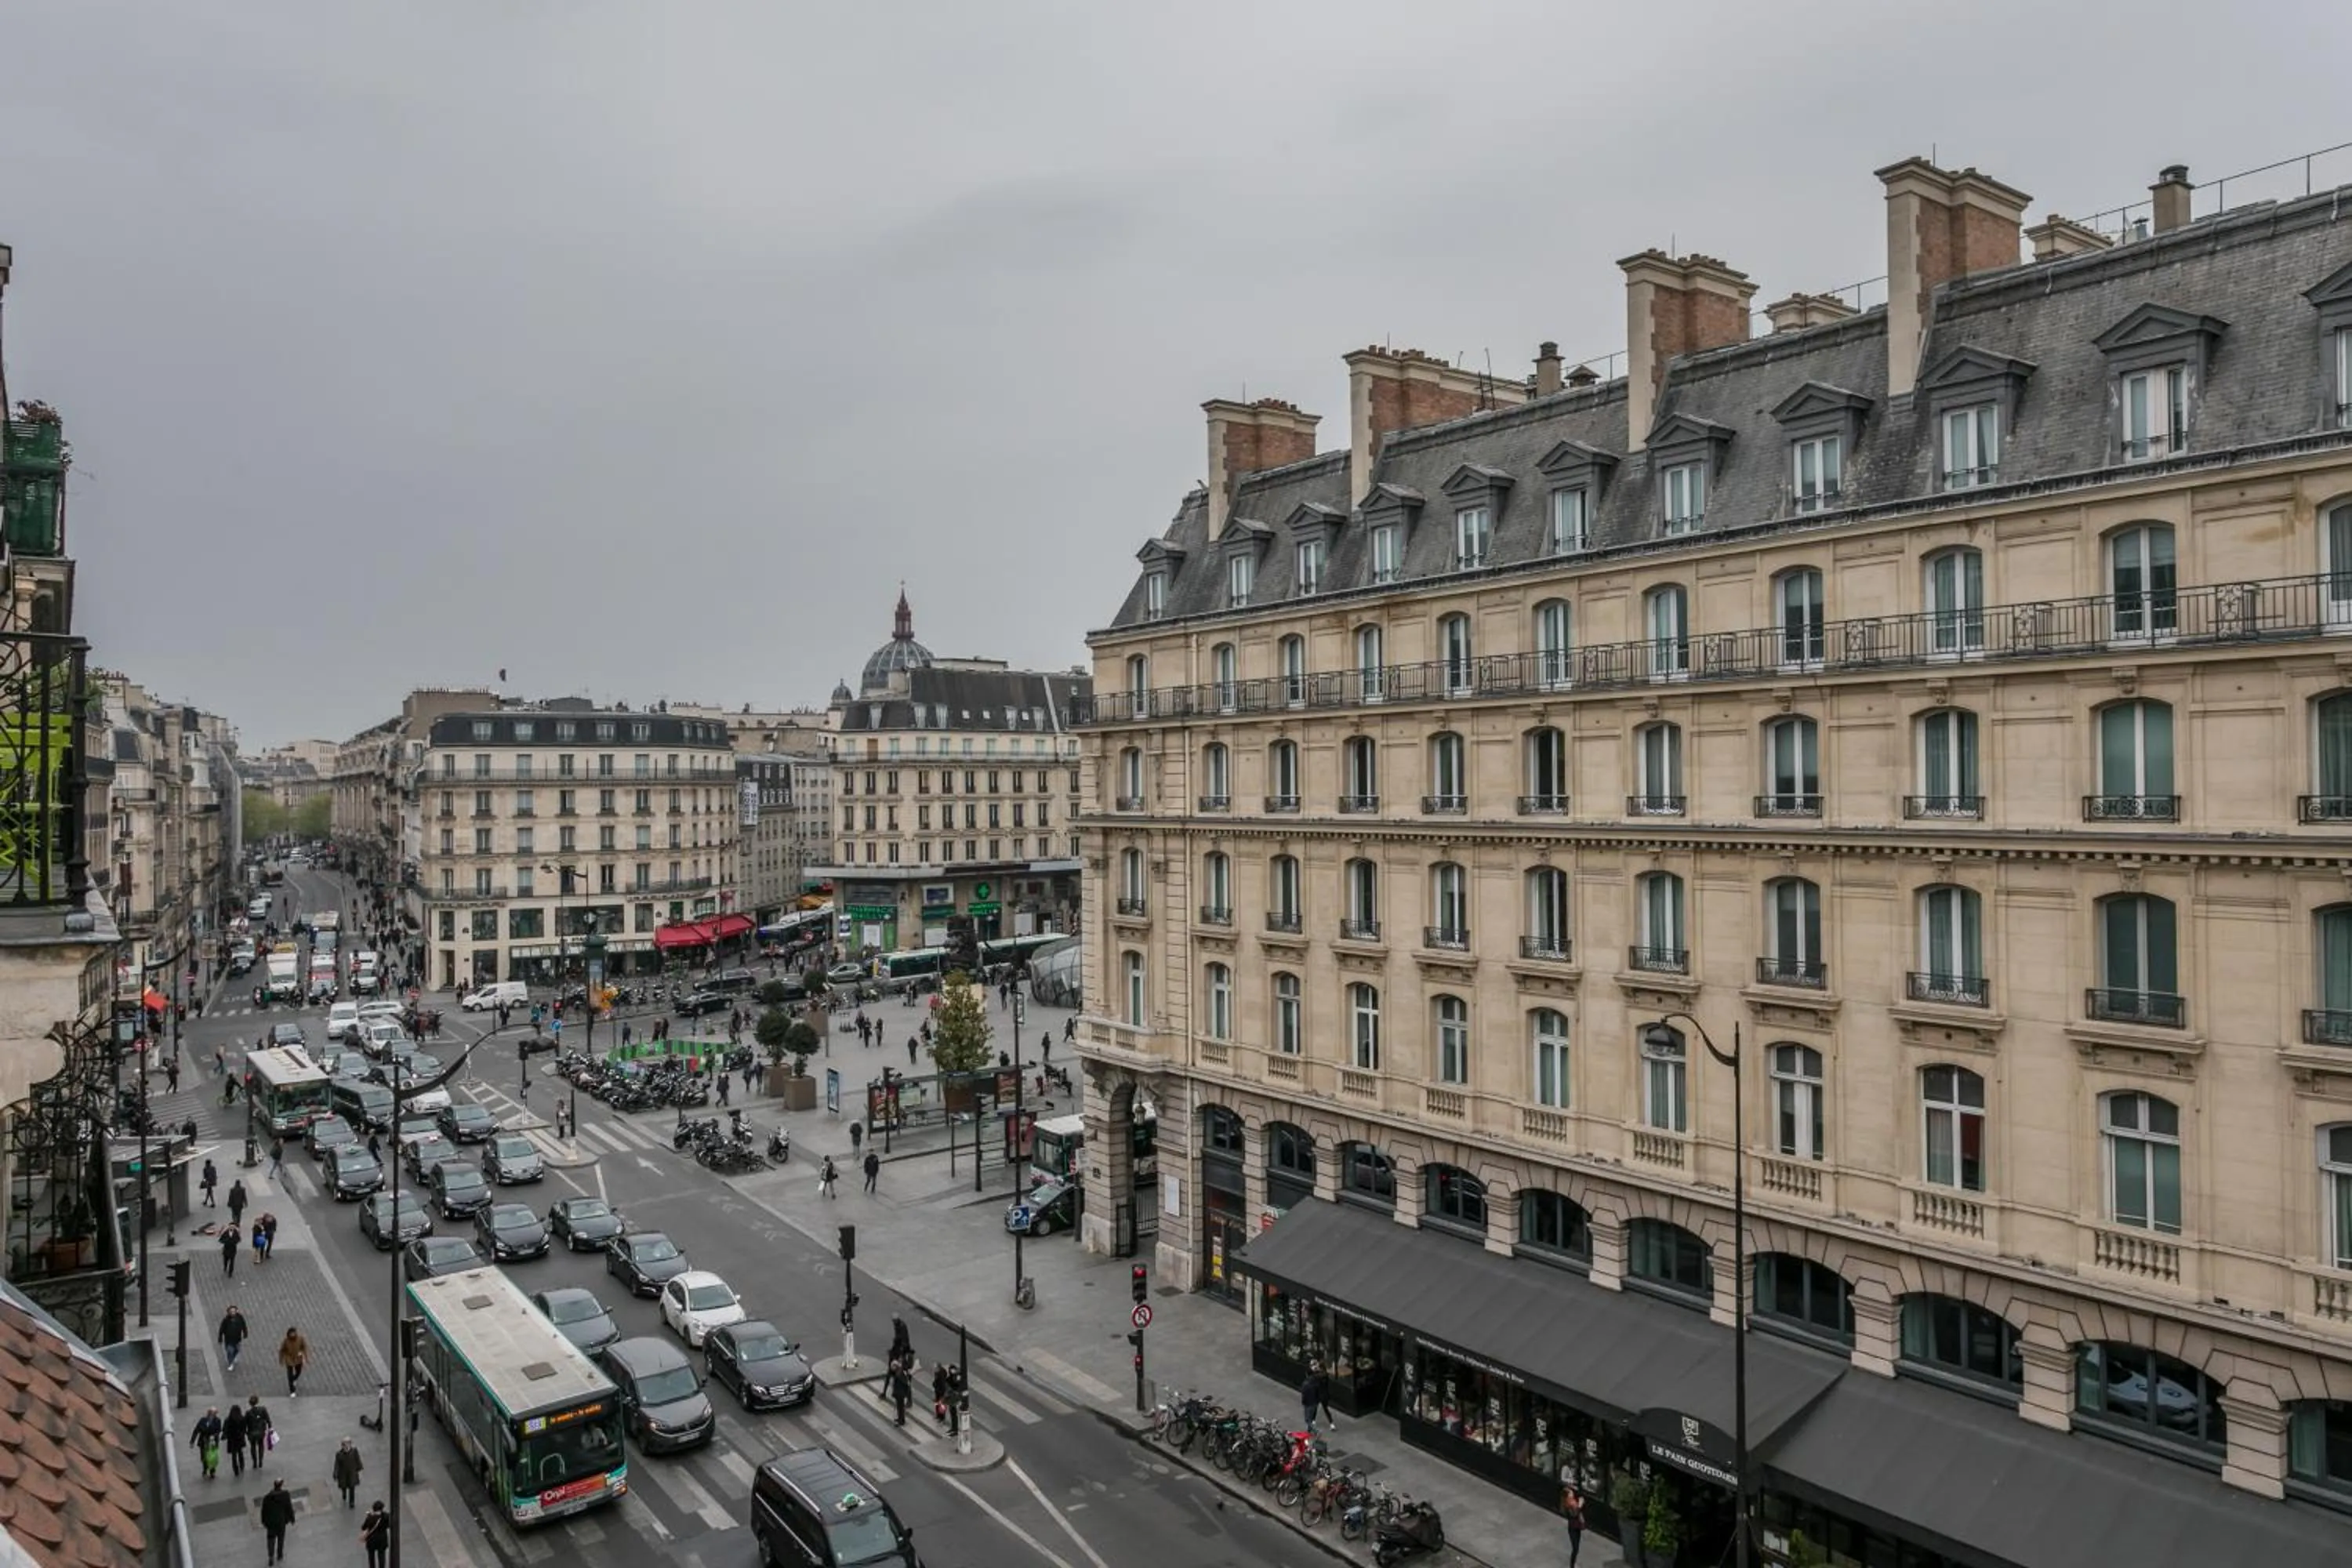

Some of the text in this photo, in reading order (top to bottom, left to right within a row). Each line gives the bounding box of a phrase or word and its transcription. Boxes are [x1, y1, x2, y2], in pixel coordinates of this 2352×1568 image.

[847, 905, 895, 913] PHARMACIE
[1012, 1210, 1023, 1225] P
[1652, 1445, 1738, 1486] LE PAIN QUOTIDIEN
